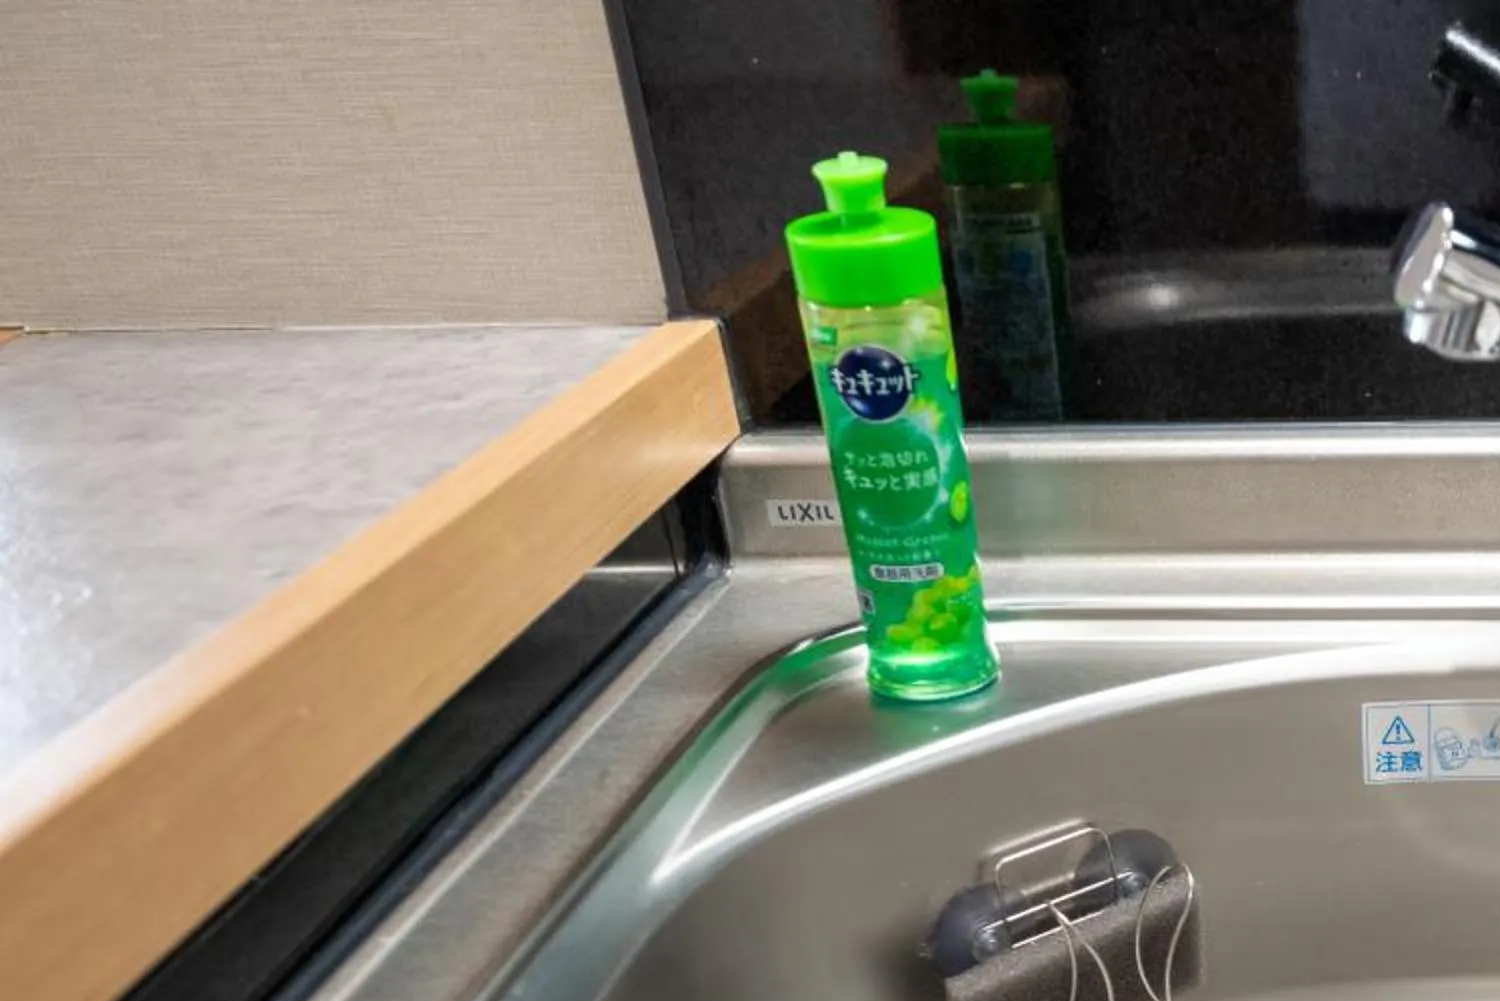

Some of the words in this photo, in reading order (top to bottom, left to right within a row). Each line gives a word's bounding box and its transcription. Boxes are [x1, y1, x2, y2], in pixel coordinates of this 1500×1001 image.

[830, 365, 919, 396] キュキュット
[777, 503, 835, 521] LIXIL
[1375, 750, 1423, 773] 注意
